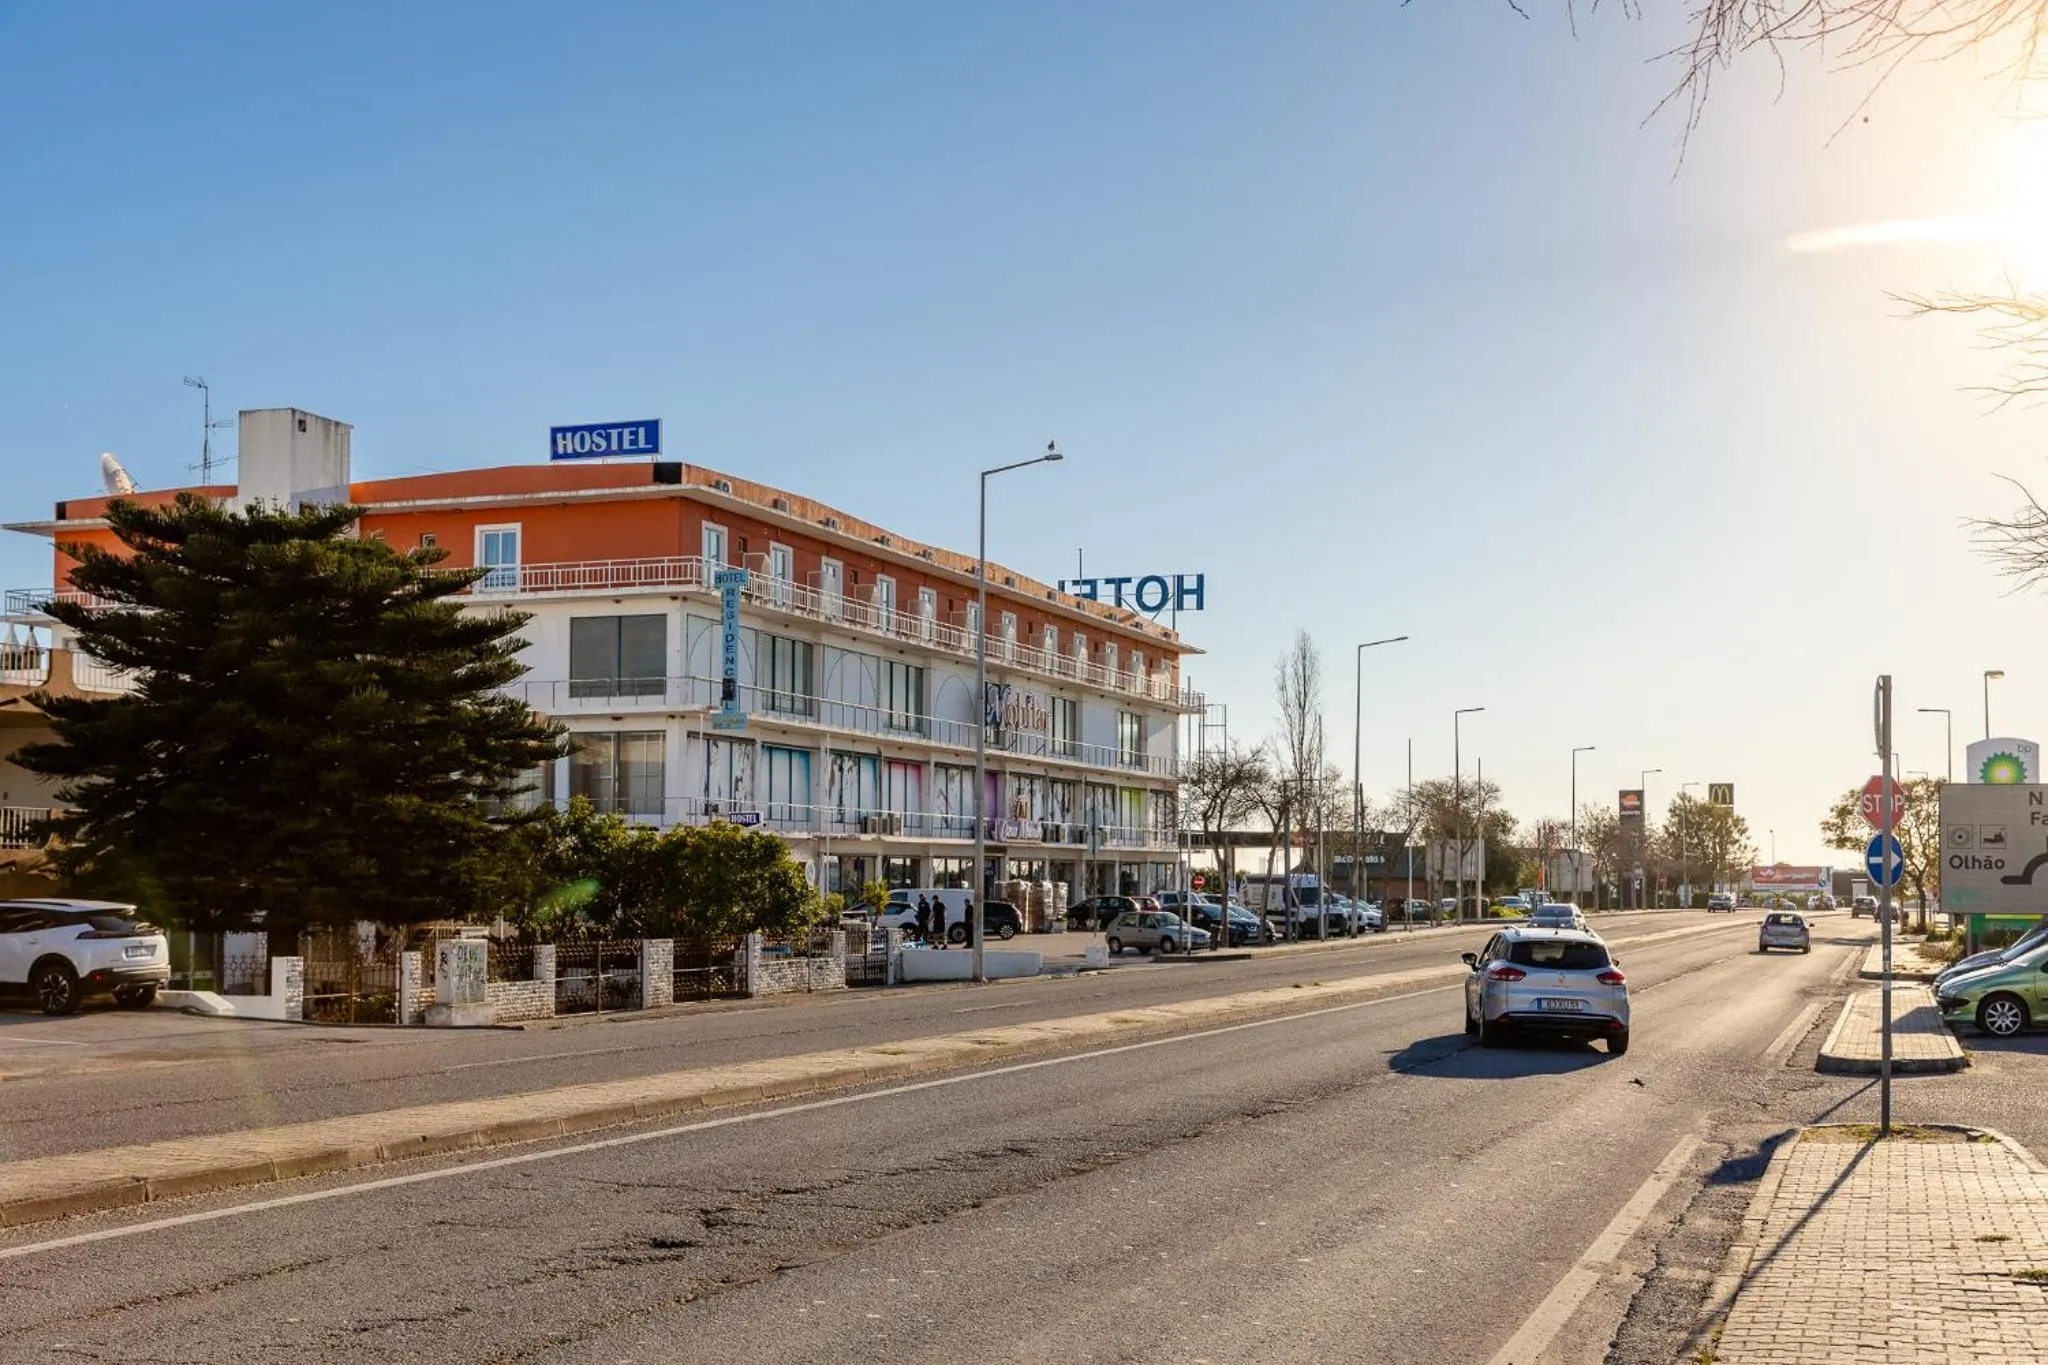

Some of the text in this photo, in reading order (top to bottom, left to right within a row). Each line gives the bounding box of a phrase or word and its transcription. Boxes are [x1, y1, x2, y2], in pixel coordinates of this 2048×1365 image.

[556, 426, 654, 454] HOSTEL
[715, 572, 746, 584] HOTEL
[725, 588, 735, 710] RESIDENCL
[2017, 744, 2032, 754] bp
[1863, 794, 1904, 813] STP
[731, 814, 757, 824] HOSTEL
[1949, 854, 2005, 870] Olhão
